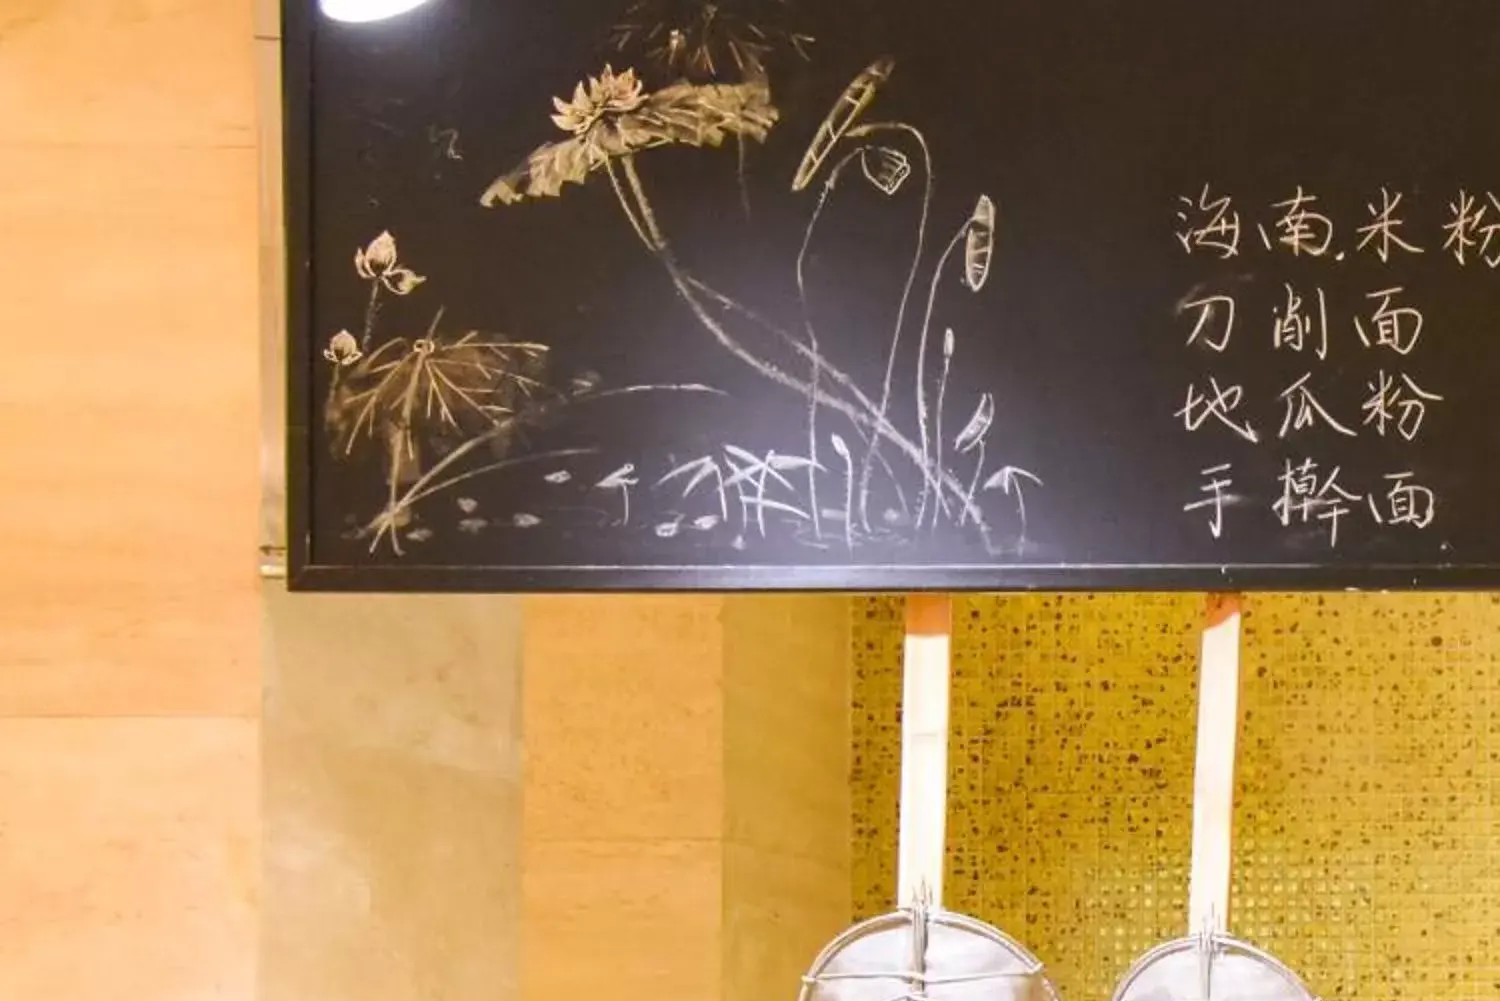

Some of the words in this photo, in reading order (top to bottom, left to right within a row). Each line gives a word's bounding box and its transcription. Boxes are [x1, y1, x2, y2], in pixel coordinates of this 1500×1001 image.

[1182, 283, 1424, 360] 刀削面
[1173, 370, 1443, 444] 地瓜粉
[1183, 456, 1435, 548] 手擀面
